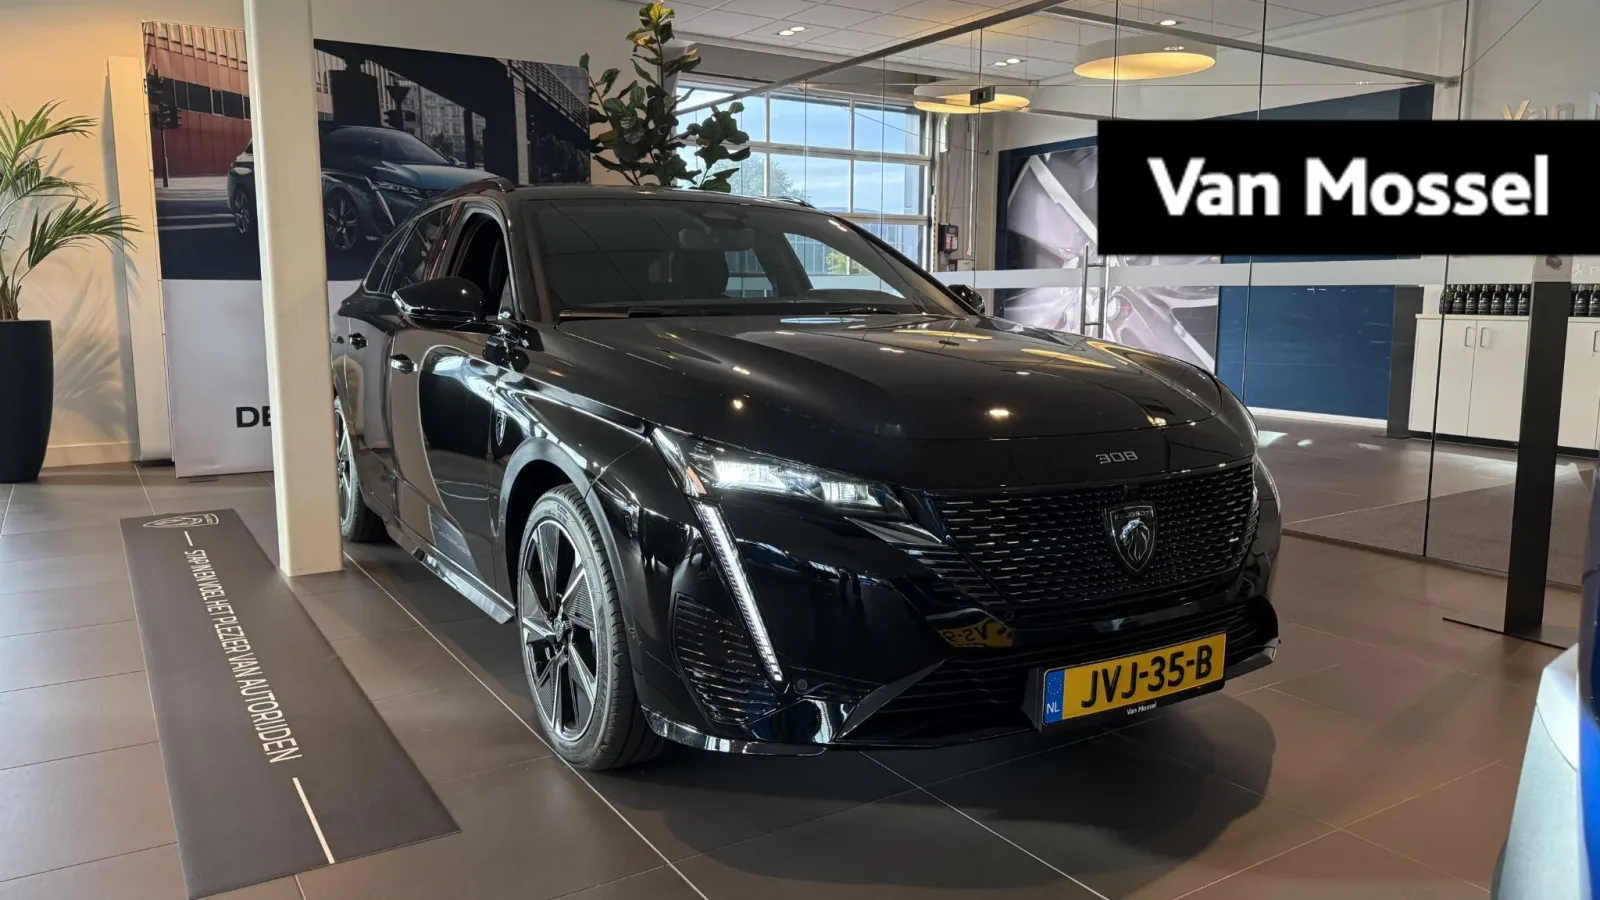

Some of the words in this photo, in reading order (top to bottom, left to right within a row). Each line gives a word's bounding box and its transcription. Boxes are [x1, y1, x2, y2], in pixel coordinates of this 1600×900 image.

[1095, 451, 1138, 465] 308
[184, 549, 210, 564] STAP
[193, 571, 218, 582] EN
[198, 580, 226, 600] VOEL
[205, 599, 234, 616] HET
[212, 615, 251, 654] PLEZIER
[228, 652, 263, 678] VAN
[1081, 645, 1213, 709] JVJ-35-B
[1046, 701, 1060, 715] NL
[1126, 707, 1137, 716] Van
[1137, 701, 1157, 713] Mossel
[237, 679, 303, 763] AUTORIJDEN
